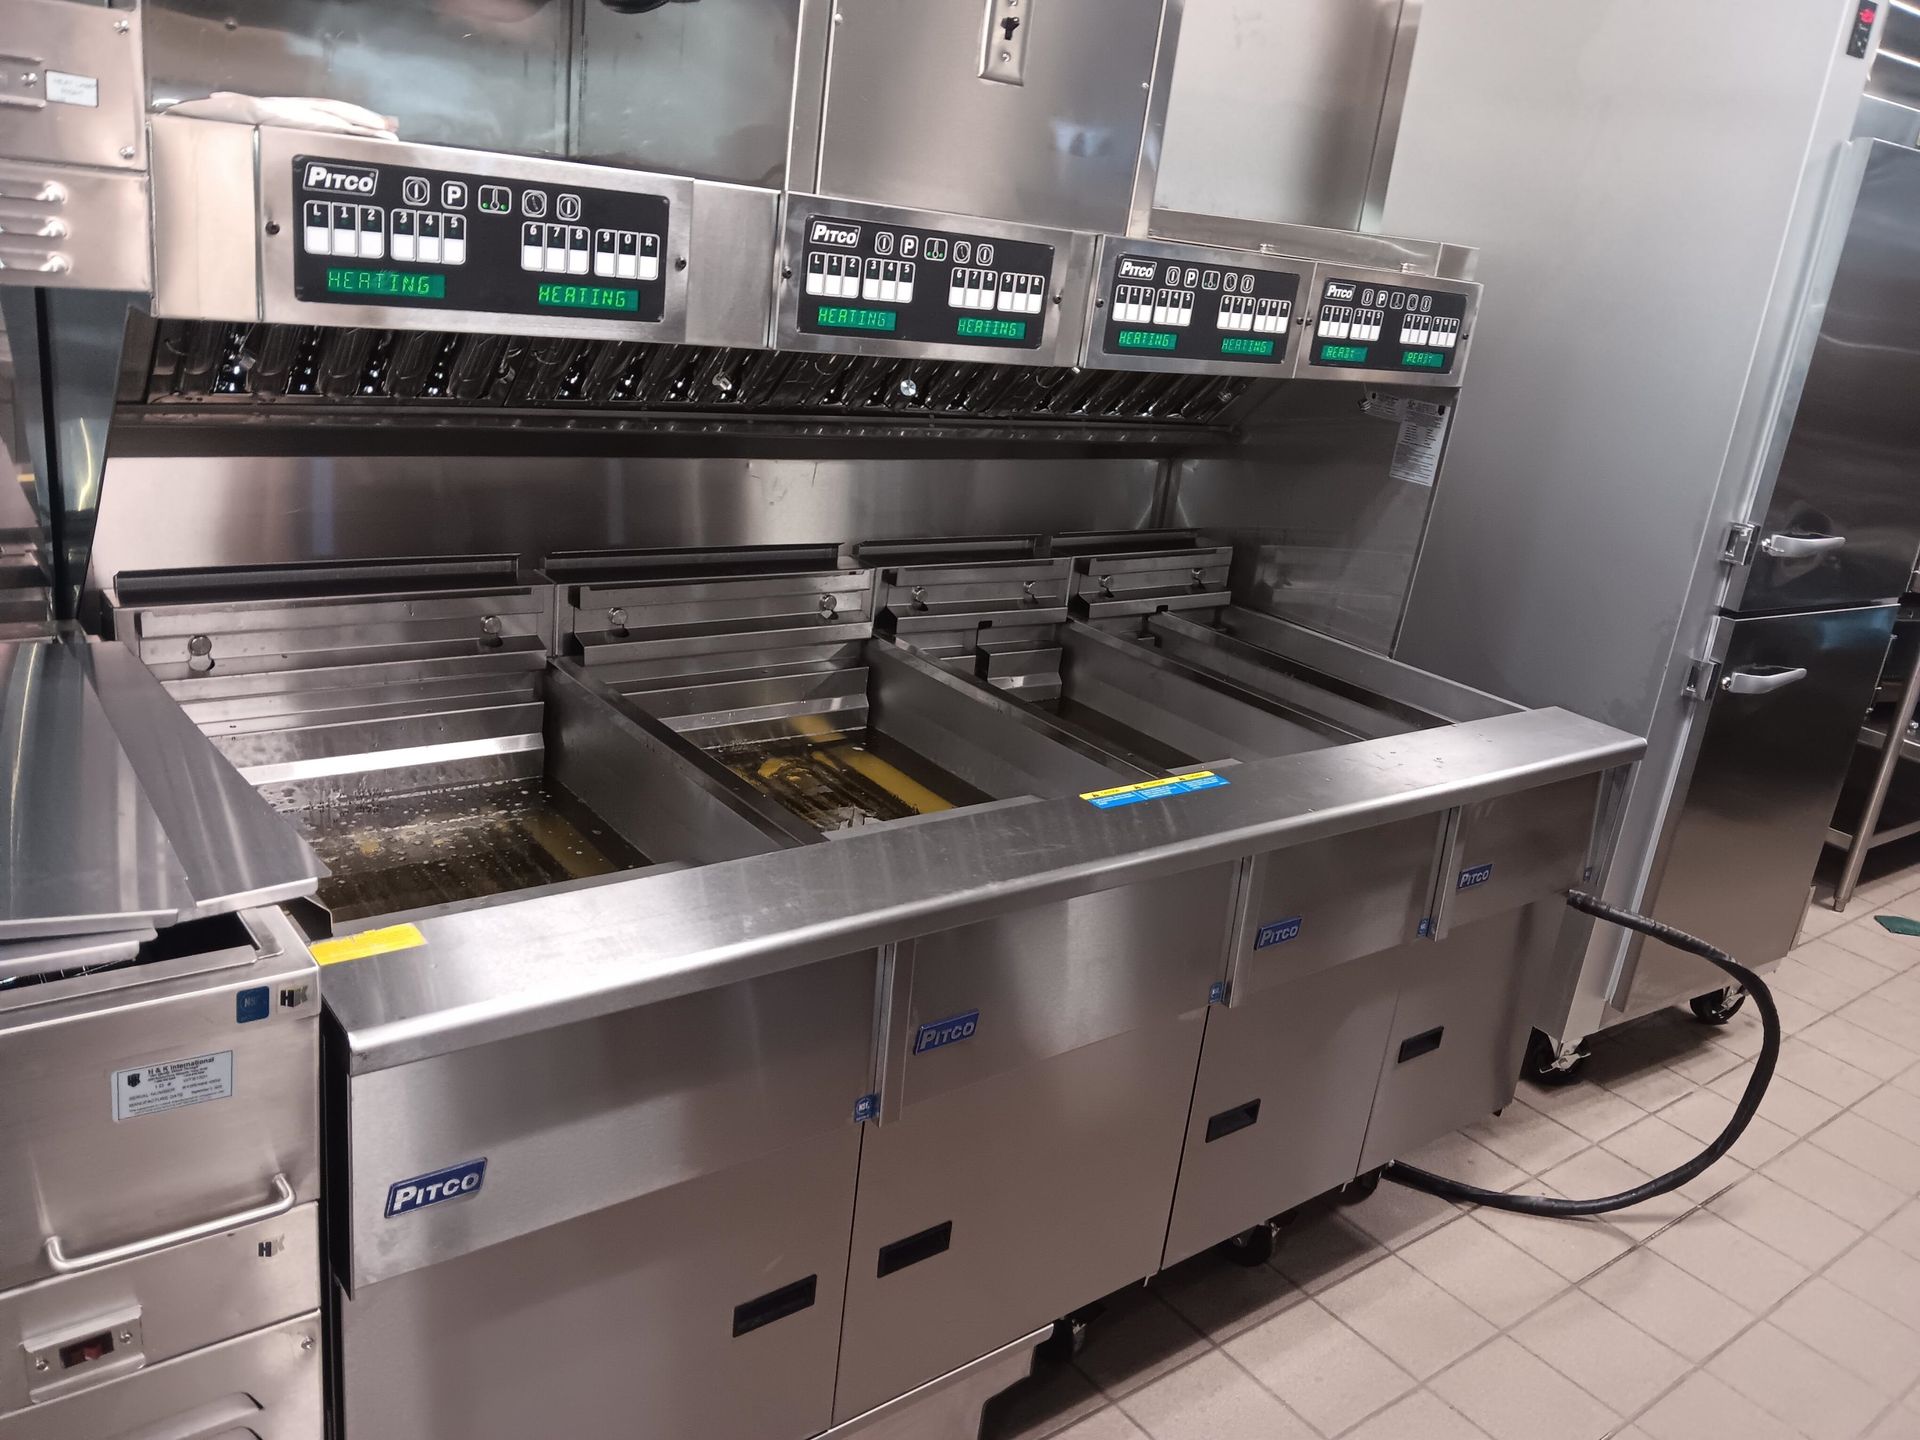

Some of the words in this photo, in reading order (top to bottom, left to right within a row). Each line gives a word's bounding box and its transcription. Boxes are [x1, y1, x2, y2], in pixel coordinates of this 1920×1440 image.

[308, 166, 373, 192] PITCO
[447, 186, 462, 204] P
[313, 204, 321, 216] L
[341, 207, 348, 218] 1
[368, 210, 375, 220] 2
[400, 212, 407, 223] 3
[425, 215, 433, 226] 4
[450, 216, 458, 228] 5
[530, 224, 537, 235] 6
[554, 227, 560, 237] 7
[576, 229, 583, 239] 8
[603, 232, 610, 242] 9
[625, 234, 631, 244] 0
[646, 237, 652, 246] R
[813, 224, 857, 244] PITCO
[904, 239, 914, 254] P
[814, 255, 820, 263] L
[832, 257, 837, 266] 1
[850, 259, 855, 267] 2
[871, 261, 876, 269] 3
[888, 263, 893, 271] 4
[904, 265, 910, 273] 5
[1120, 261, 1153, 277] PITCO
[328, 272, 430, 294] HEATING
[957, 269, 962, 278] 6
[987, 273, 992, 281] 8
[1006, 275, 1011, 283] 9
[1187, 272, 1195, 284] P
[538, 286, 625, 307] HEATING
[1327, 285, 1353, 298] PITCO
[1378, 293, 1385, 304] P
[818, 308, 886, 326] HEATING
[958, 319, 1016, 336] HEATING
[1119, 331, 1169, 347] HEATING
[1222, 338, 1267, 352] HEATING
[1460, 870, 1489, 887] PITCO
[1260, 926, 1298, 946] PITCO
[920, 1022, 975, 1050] PITCO
[170, 1057, 214, 1070] International
[393, 1173, 479, 1211] PITCO
